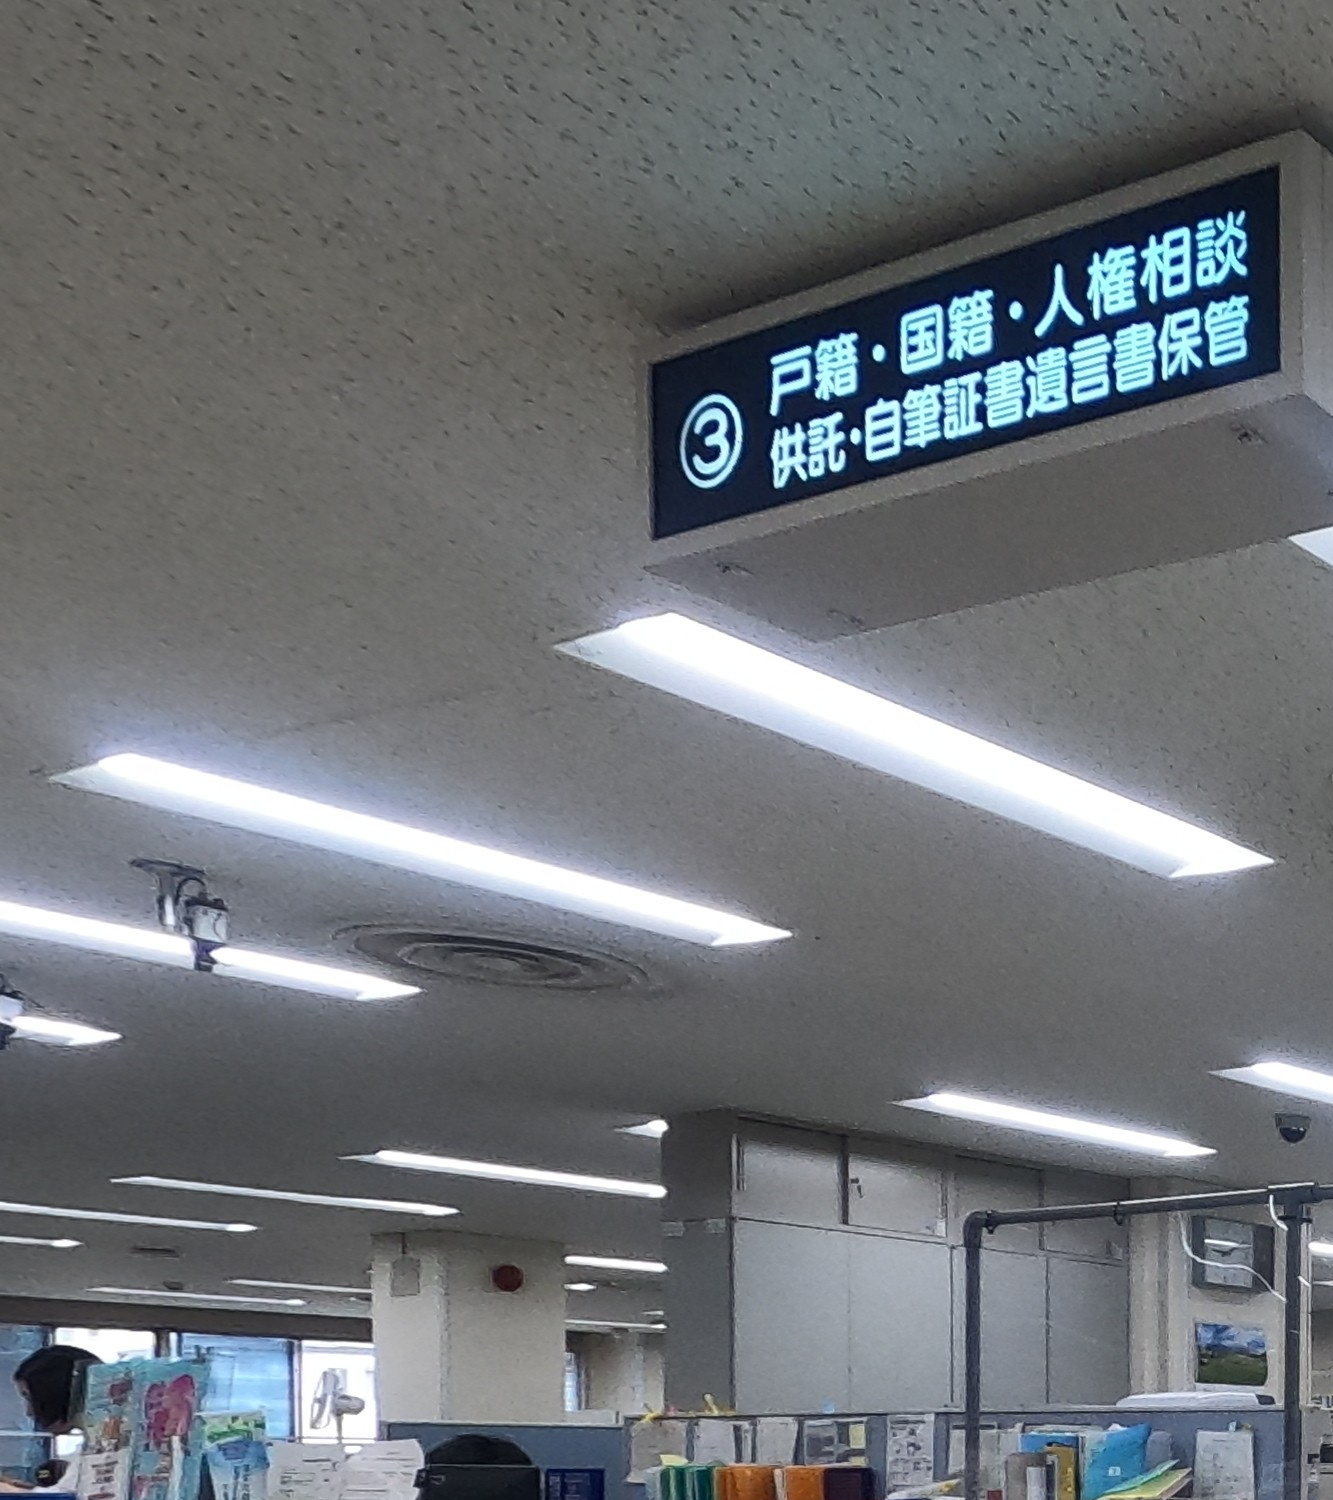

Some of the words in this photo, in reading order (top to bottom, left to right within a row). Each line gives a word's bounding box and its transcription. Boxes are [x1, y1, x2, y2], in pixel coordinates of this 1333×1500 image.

[770, 211, 1248, 415] 戸籍・国籍・人権相談
[770, 295, 1250, 488] 供託・自筆証書遺言書保管
